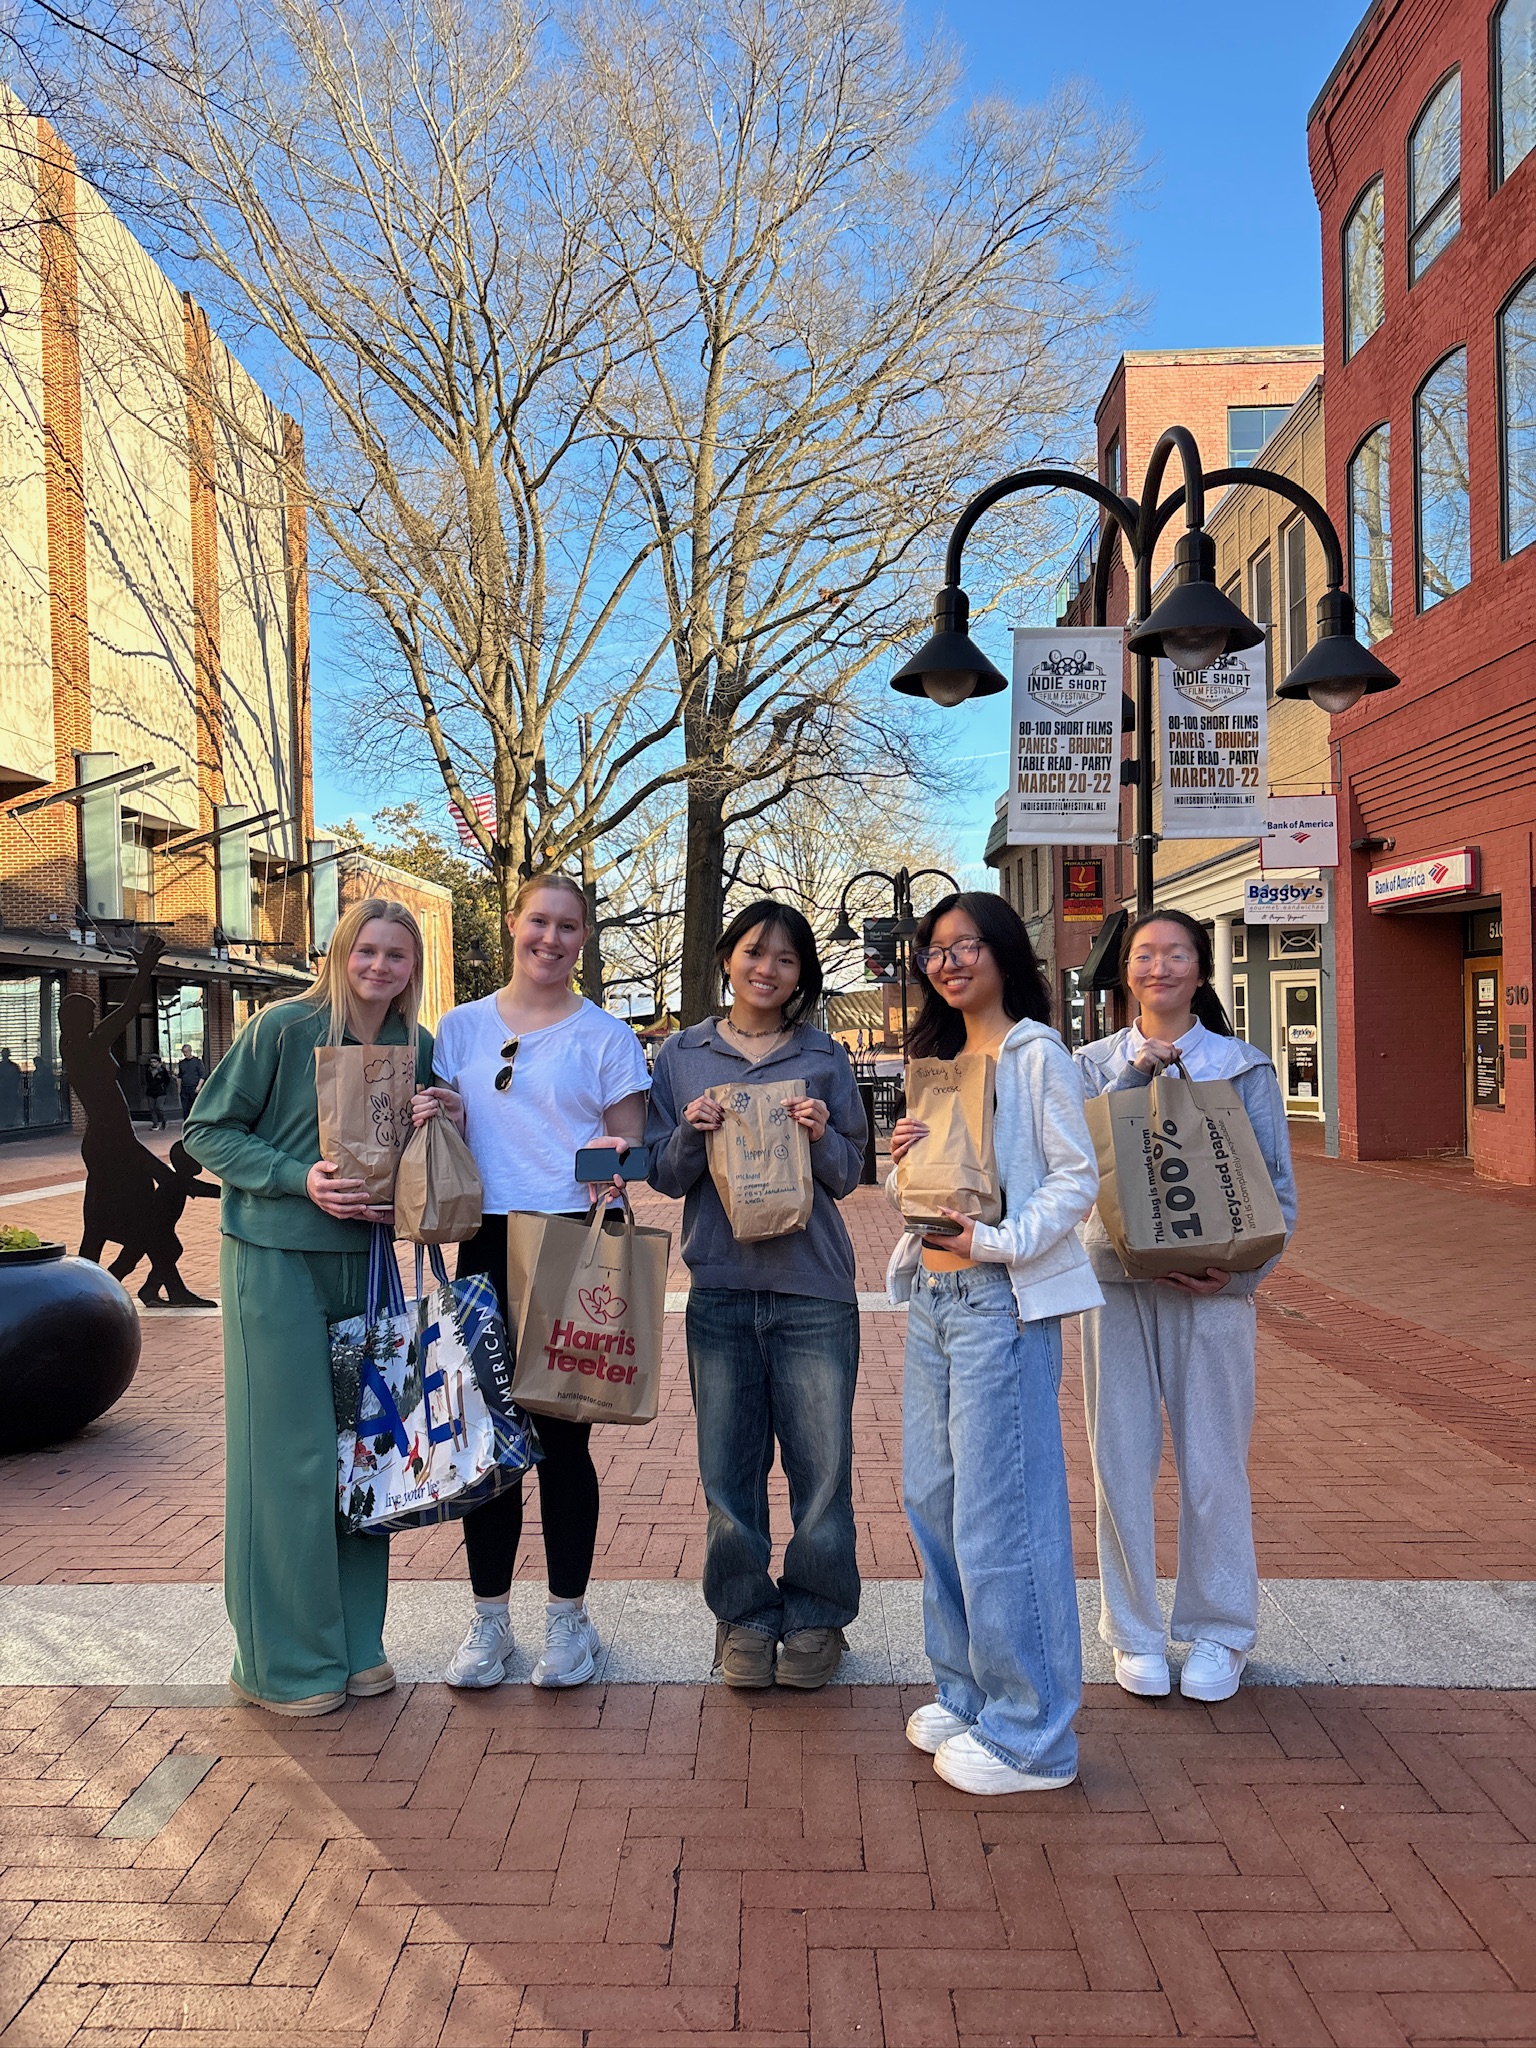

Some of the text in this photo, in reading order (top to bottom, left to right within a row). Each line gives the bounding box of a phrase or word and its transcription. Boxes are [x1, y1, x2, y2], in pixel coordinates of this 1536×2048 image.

[1028, 677, 1107, 691] INDIE SHORT
[1173, 671, 1251, 686] INDIE SHORT
[1061, 692, 1090, 700] FESTIVAL
[1206, 687, 1235, 695] FESTIVAL
[1019, 721, 1113, 735] 80-100 SHORT FILMS
[1168, 715, 1259, 730] 80-100 SHORT FILMS
[1018, 737, 1057, 754] PANELS
[1069, 737, 1112, 754] BRUNCH
[1169, 732, 1205, 749] PANELS
[1215, 731, 1259, 748] BRUNCH
[1018, 756, 1045, 771] TABLE
[1048, 756, 1072, 771] READ
[1082, 756, 1112, 771] PARTY
[1169, 751, 1195, 765] TABLE
[1197, 751, 1219, 765] READ
[1229, 750, 1259, 765] PARTY
[1018, 773, 1111, 793] MARCH 20-22
[1170, 767, 1259, 788] MARCH 20-22
[1020, 802, 1106, 811] INDIESHORTFILMFESTIVAL.NET
[1174, 796, 1255, 805] INDIESHORTFILMFESTIVAL.NET
[1267, 819, 1334, 830] Bank of America
[1375, 872, 1425, 895] Bank of America
[1249, 885, 1323, 901] Baggby's
[1249, 904, 1280, 912] gourmet
[1505, 985, 1529, 1006] 510
[916, 1067, 948, 1080] Turkey
[736, 1137, 747, 1147] BE
[1205, 1116, 1229, 1160] paper
[1142, 1128, 1165, 1244] This bag is made from
[1151, 1119, 1203, 1239] 100%
[1233, 1155, 1250, 1204] completely
[1215, 1163, 1244, 1234] recycled
[1244, 1204, 1253, 1213] is
[1246, 1212, 1256, 1229] and
[551, 1319, 636, 1356] Harris
[476, 1306, 518, 1417] AMERICAN
[544, 1344, 638, 1385] Teeter
[557, 1391, 613, 1409] harristeeter.com
[385, 1492, 402, 1507] live
[402, 1487, 426, 1507] your
